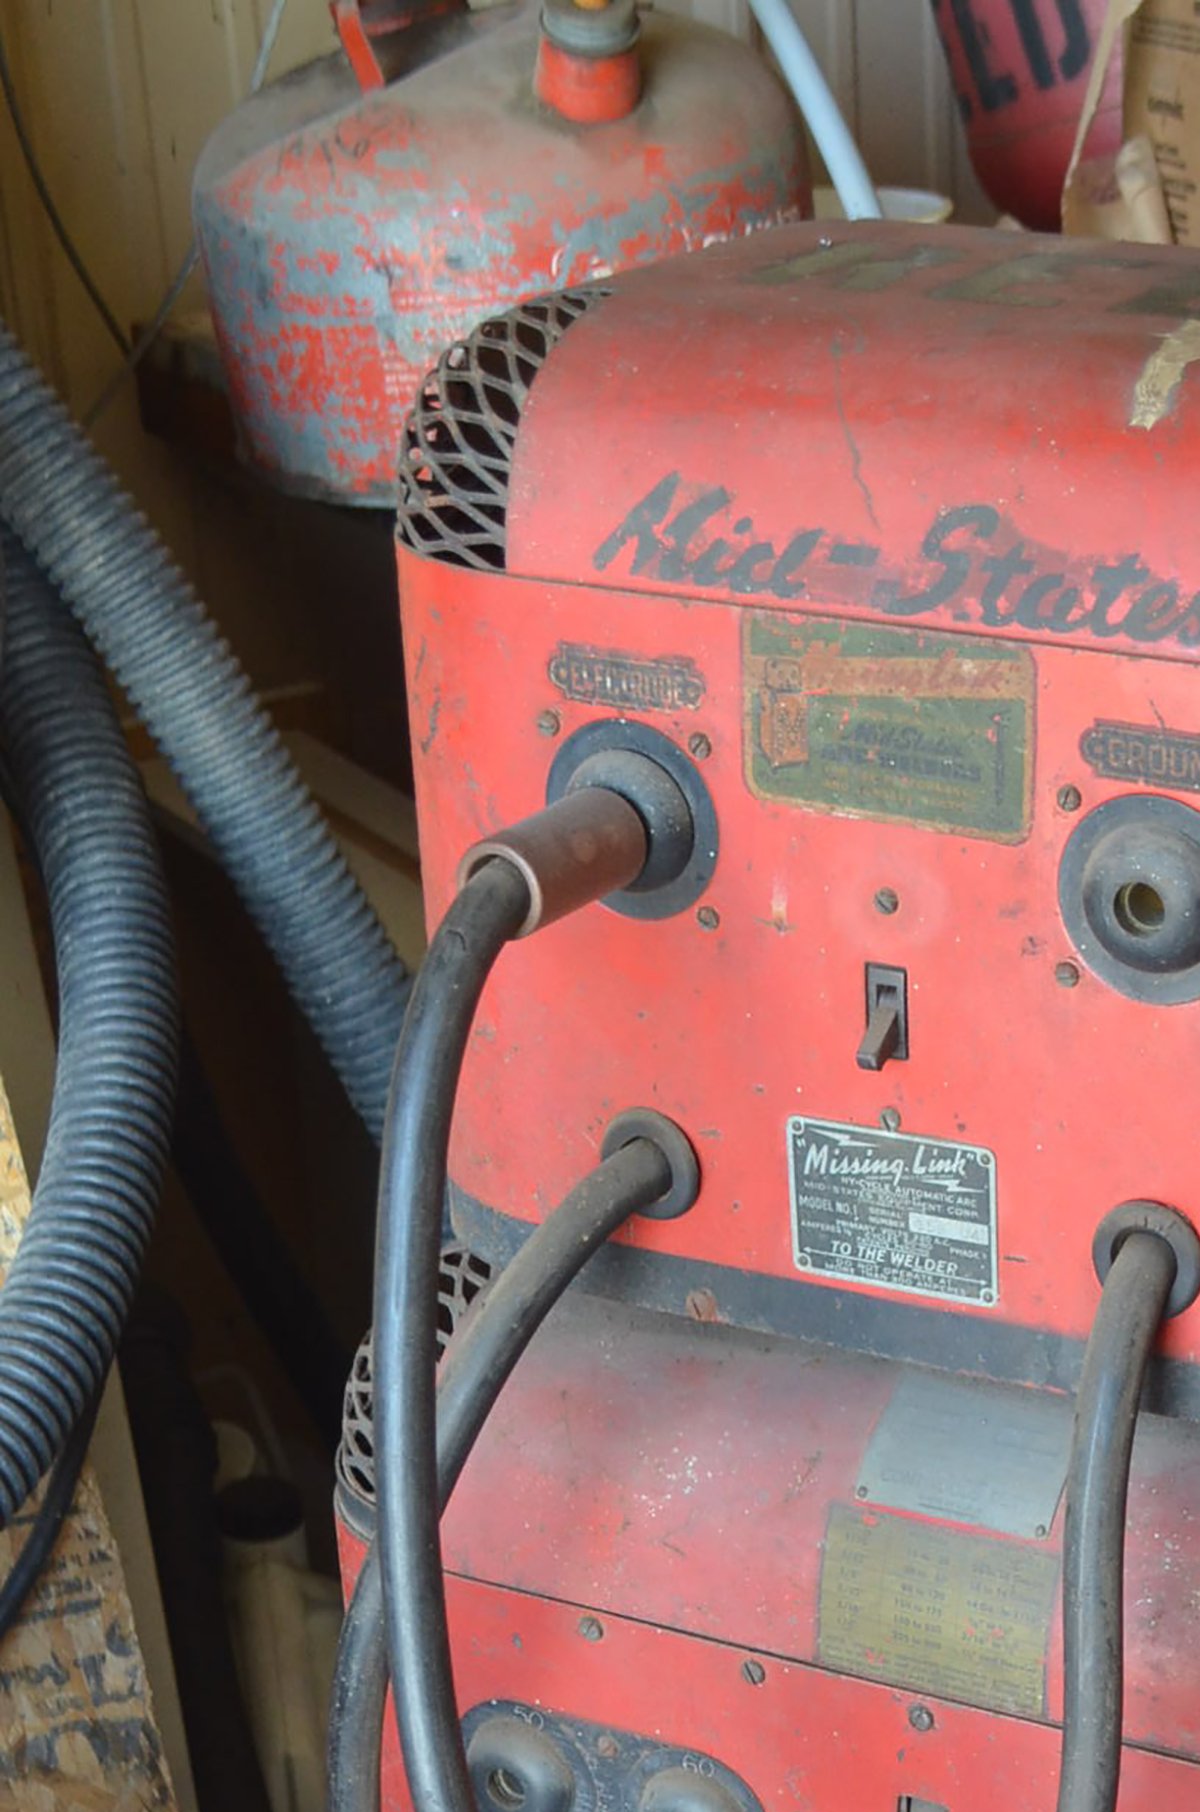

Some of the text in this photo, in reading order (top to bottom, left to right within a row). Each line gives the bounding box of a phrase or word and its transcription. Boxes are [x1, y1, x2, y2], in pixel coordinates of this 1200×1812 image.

[930, 0, 1091, 123] ED
[798, 1193, 833, 1211] MODEL
[830, 1239, 958, 1276] TO THE WELDER
[512, 1706, 544, 1731] 50
[682, 1754, 716, 1779] 60
